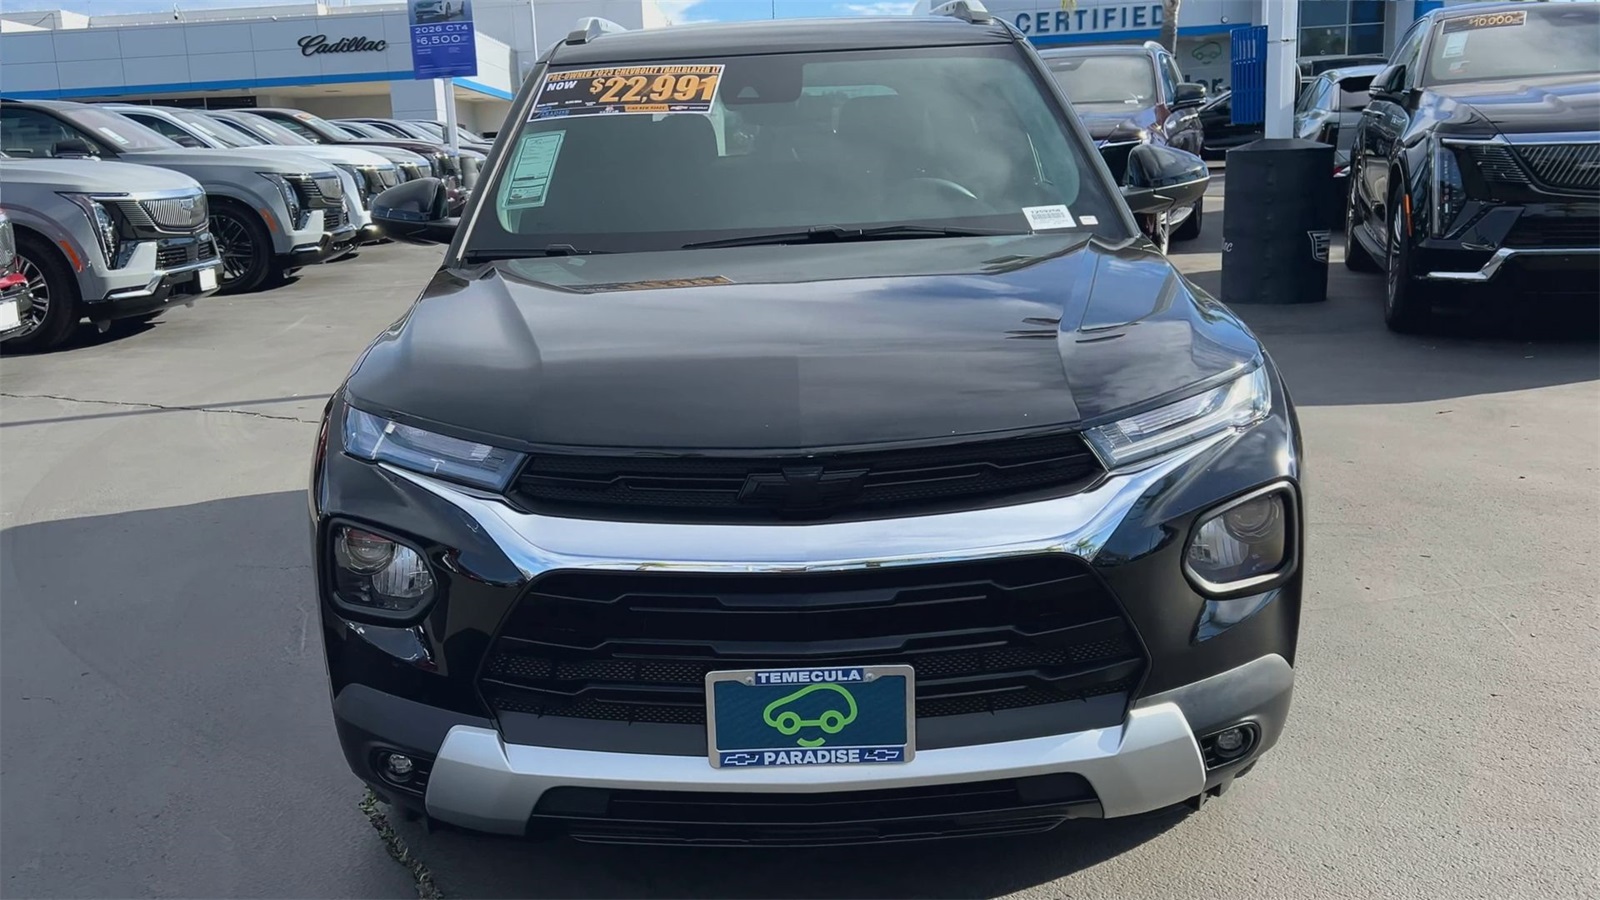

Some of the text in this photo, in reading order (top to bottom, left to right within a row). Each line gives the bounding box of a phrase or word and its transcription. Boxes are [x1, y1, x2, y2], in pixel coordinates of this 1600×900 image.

[1015, 5, 1164, 34] CERTIFIED
[415, 24, 468, 34] 2026 CT4
[297, 34, 386, 57] Cadillac
[548, 71, 593, 82] PRE-OWNED
[614, 67, 660, 77] CHEVROLET
[660, 65, 711, 75] TRAILBLAZER
[546, 73, 718, 104] NOW $22,991
[757, 669, 862, 684] TEMECULA
[763, 749, 861, 766] PARADISE
